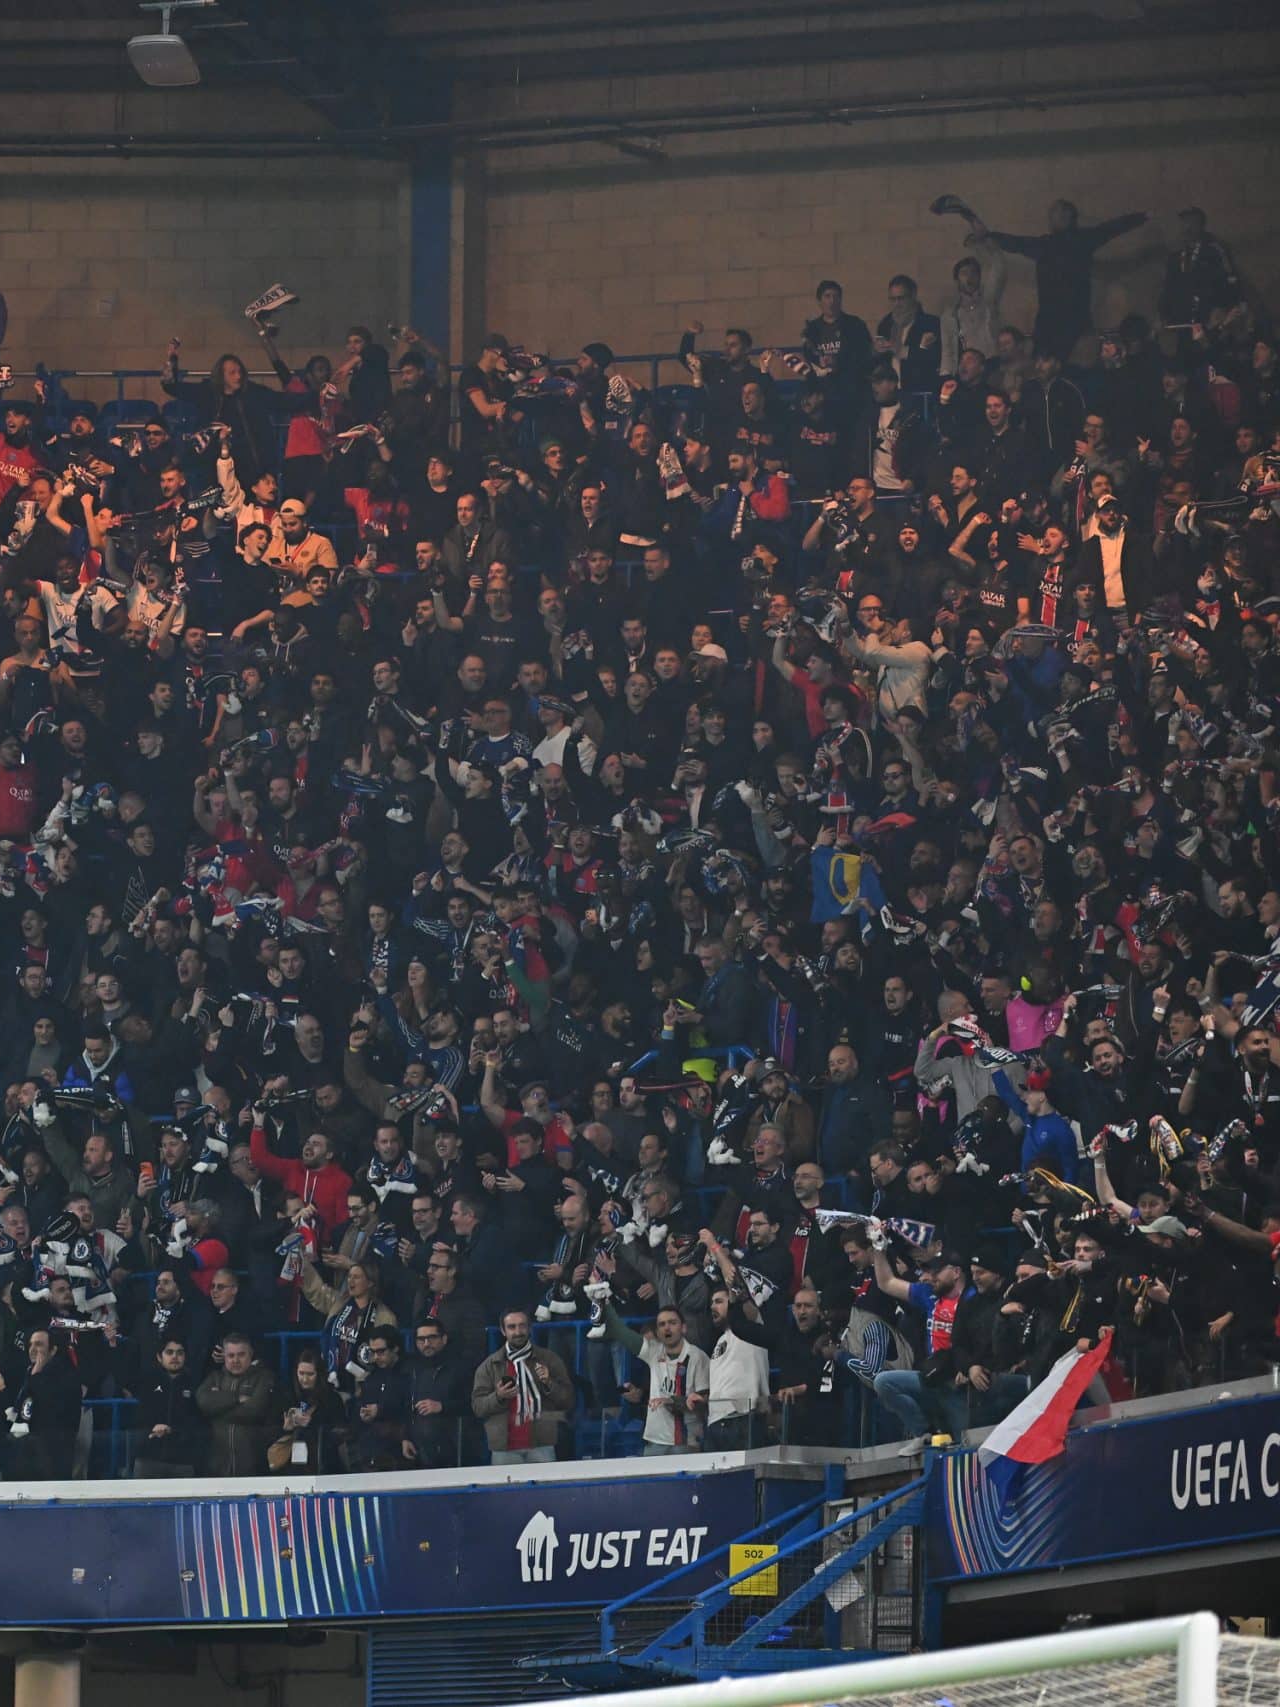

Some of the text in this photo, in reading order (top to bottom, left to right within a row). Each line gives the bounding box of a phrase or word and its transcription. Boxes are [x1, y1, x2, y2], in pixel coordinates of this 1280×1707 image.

[1171, 1438, 1251, 1511] UEFA
[566, 1527, 708, 1577] JUST EAT
